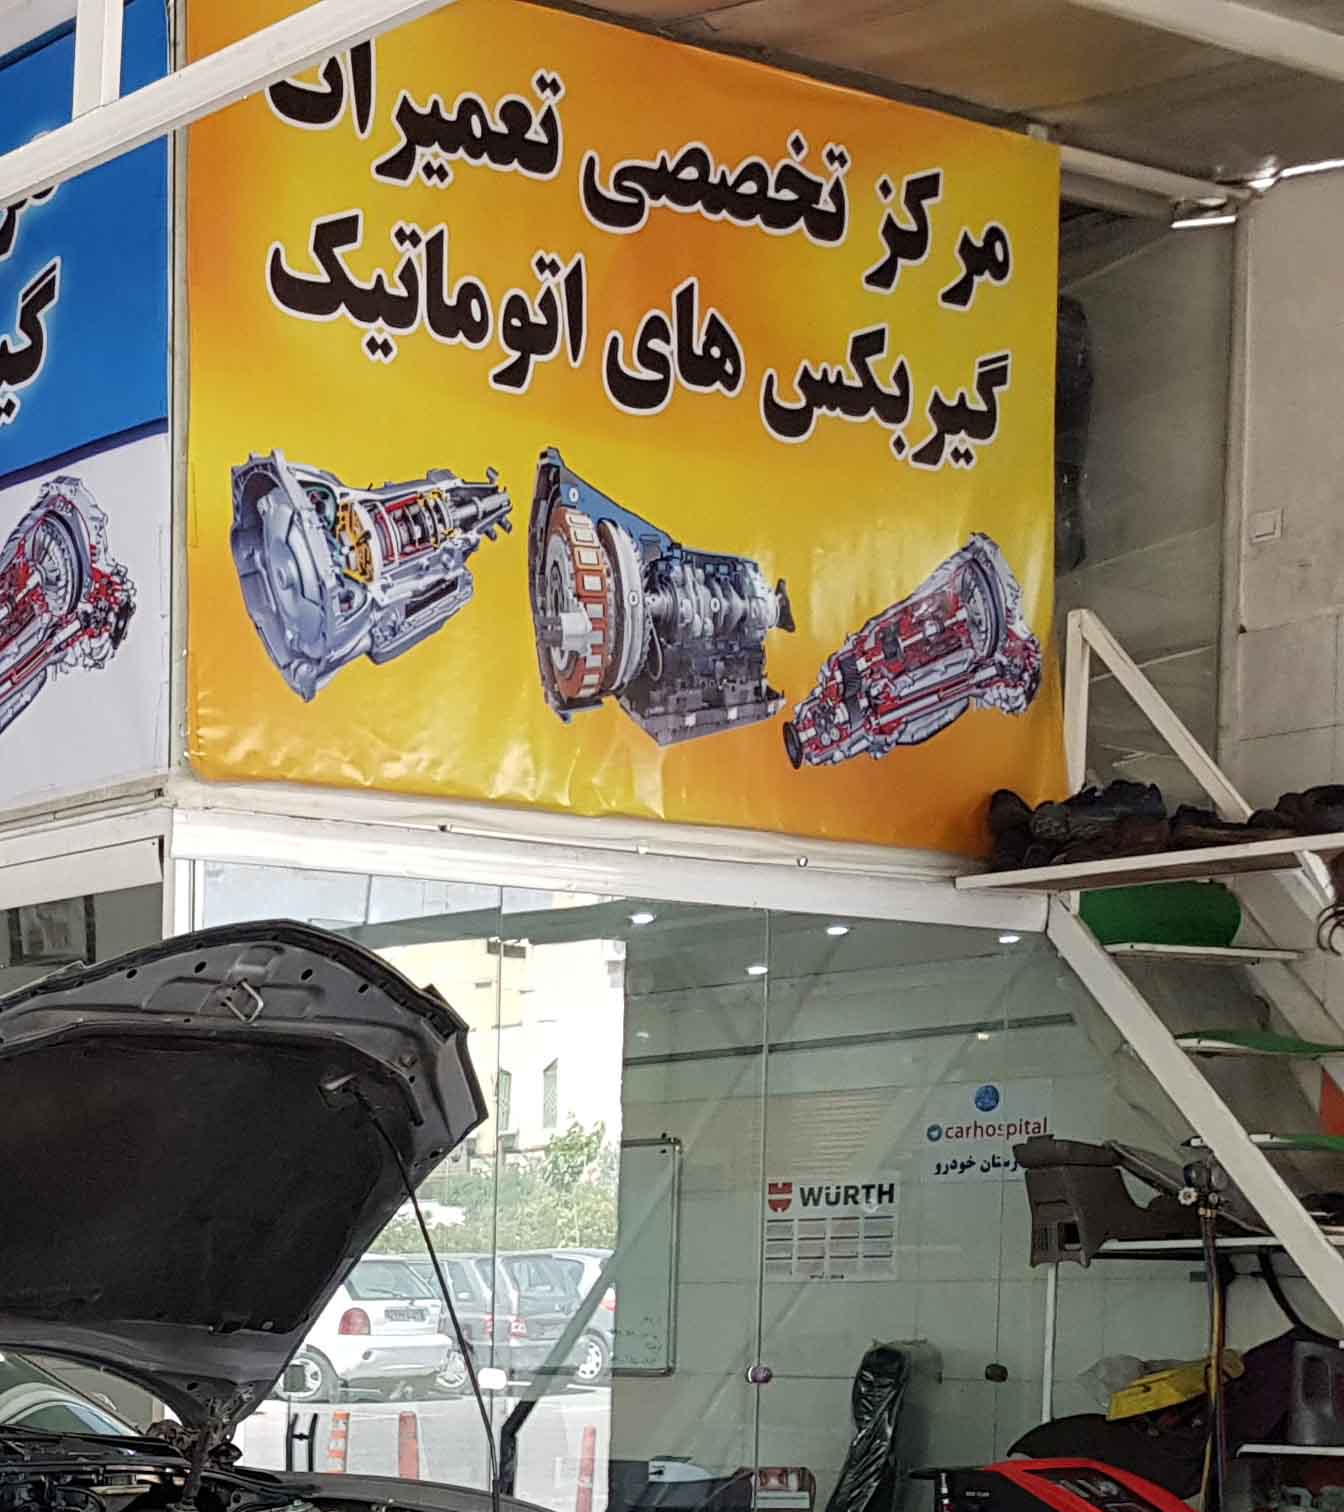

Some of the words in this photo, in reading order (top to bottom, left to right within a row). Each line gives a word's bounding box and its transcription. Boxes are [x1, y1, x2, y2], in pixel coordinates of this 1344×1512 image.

[580, 131, 849, 246] تخصصی
[863, 170, 1012, 309] مرکز
[266, 209, 585, 392] اتوماتیک
[604, 278, 746, 416] های
[761, 328, 1012, 471] گیربکس
[934, 1155, 976, 1175] خودرو
[944, 1116, 1048, 1140] carhospital
